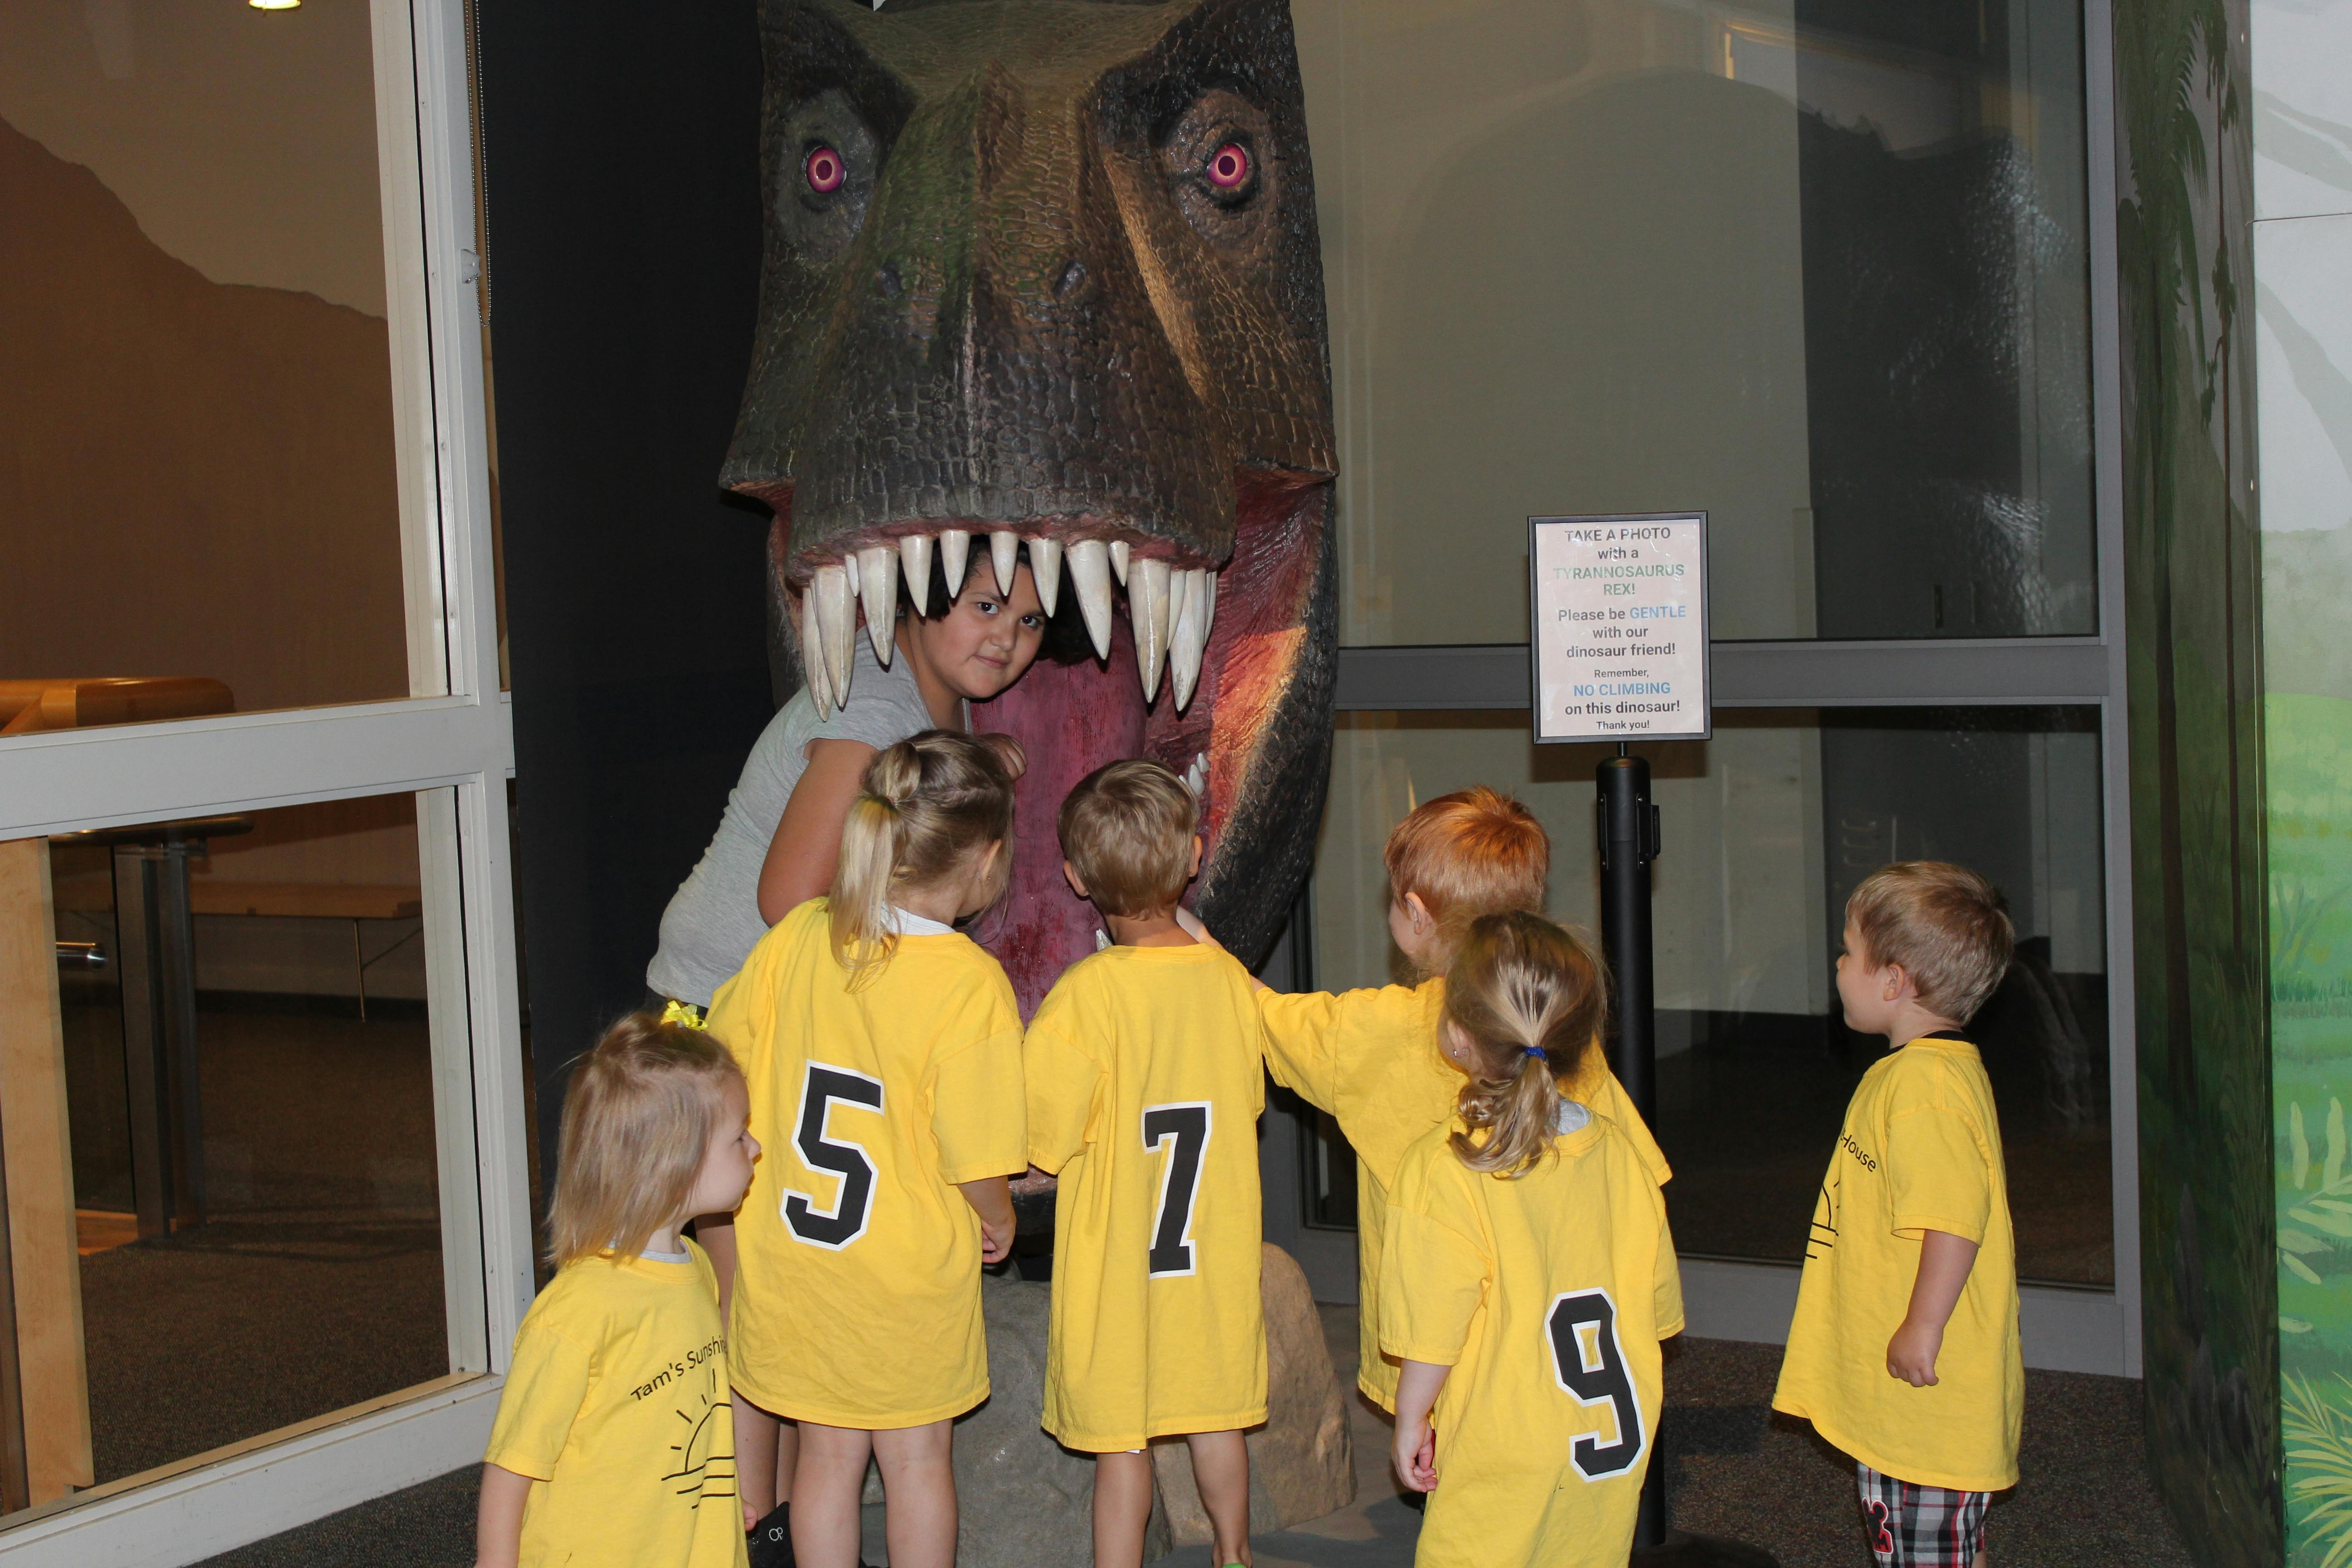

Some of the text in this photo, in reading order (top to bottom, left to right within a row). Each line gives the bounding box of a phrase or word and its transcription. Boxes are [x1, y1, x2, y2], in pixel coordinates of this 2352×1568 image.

[1564, 527, 1671, 542] TAKE A PHOTO
[1597, 546, 1639, 560] with a
[1553, 564, 1685, 579] TYRANNOSAURUS
[1603, 583, 1635, 596] REX!
[1558, 605, 1686, 622] Please be GENTLE
[1592, 626, 1649, 639] with our
[1566, 642, 1676, 658] dinosaur friend!
[1594, 668, 1649, 678] Remember,
[1573, 682, 1671, 697] NO CLIMBING
[1565, 700, 1680, 715] on this dinosaur!
[1596, 720, 1650, 731] Thank you!
[780, 1058, 885, 1251] 5
[1141, 1101, 1212, 1280] 7
[630, 1335, 727, 1401] Tam's Sunshi
[1544, 1287, 1647, 1483] 9
